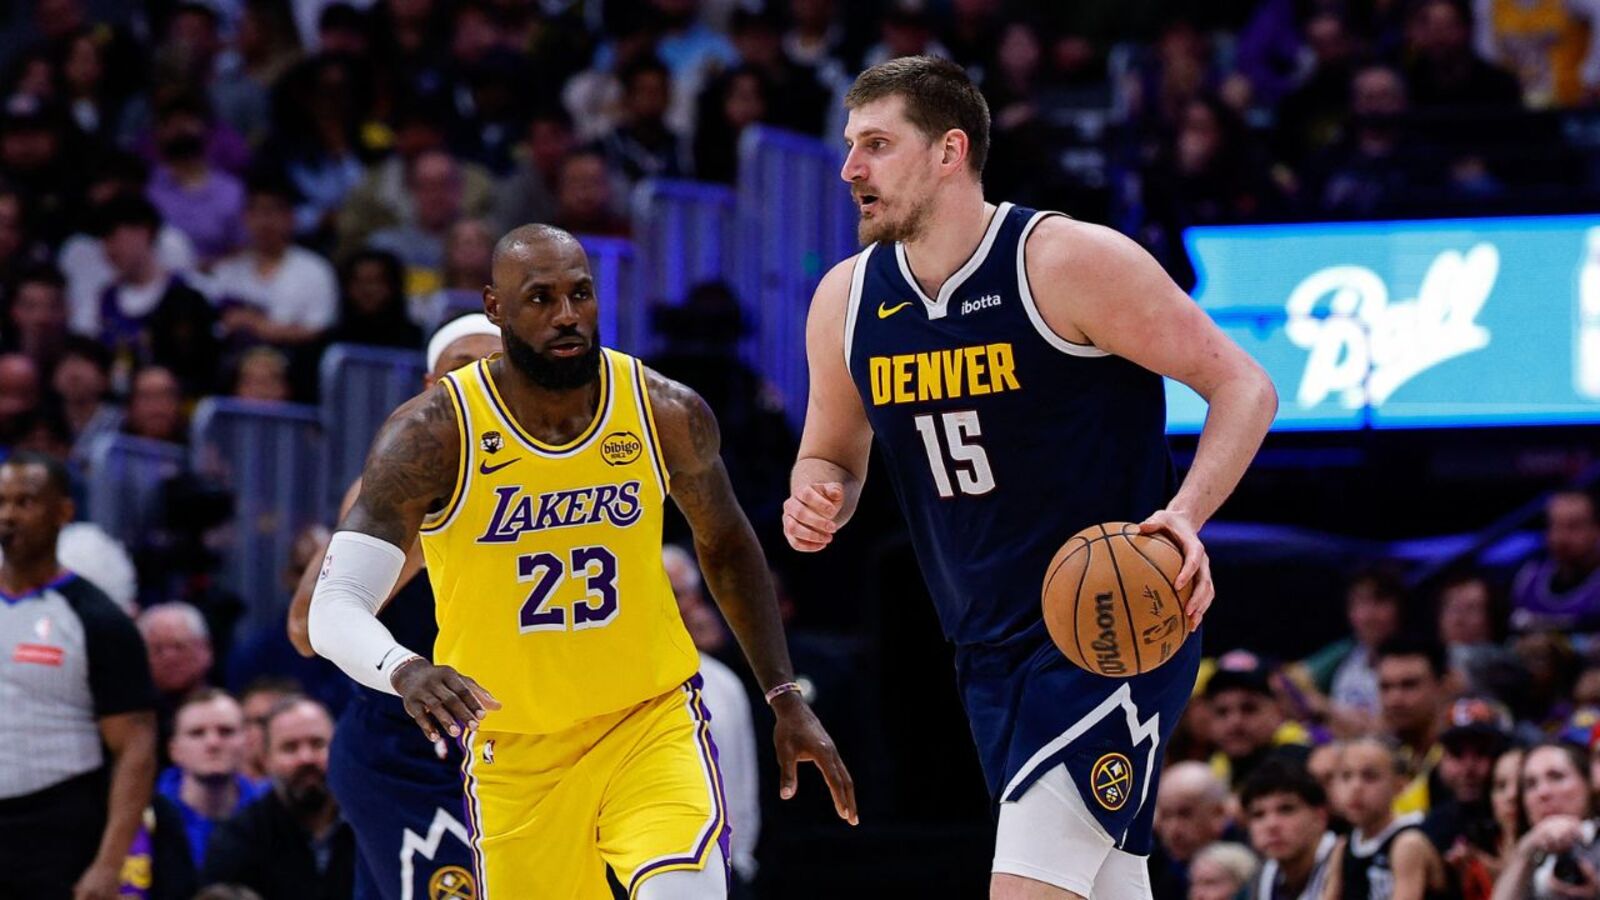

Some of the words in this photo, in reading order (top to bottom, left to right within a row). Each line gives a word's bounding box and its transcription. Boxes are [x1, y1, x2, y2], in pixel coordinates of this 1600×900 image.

[961, 294, 1002, 316] ibotta
[869, 342, 1021, 406] DENVER
[604, 440, 639, 455] bibigo
[914, 409, 997, 498] 15
[475, 479, 643, 544] LAKERS
[516, 544, 620, 634] 23
[1091, 590, 1129, 675] Wilson
